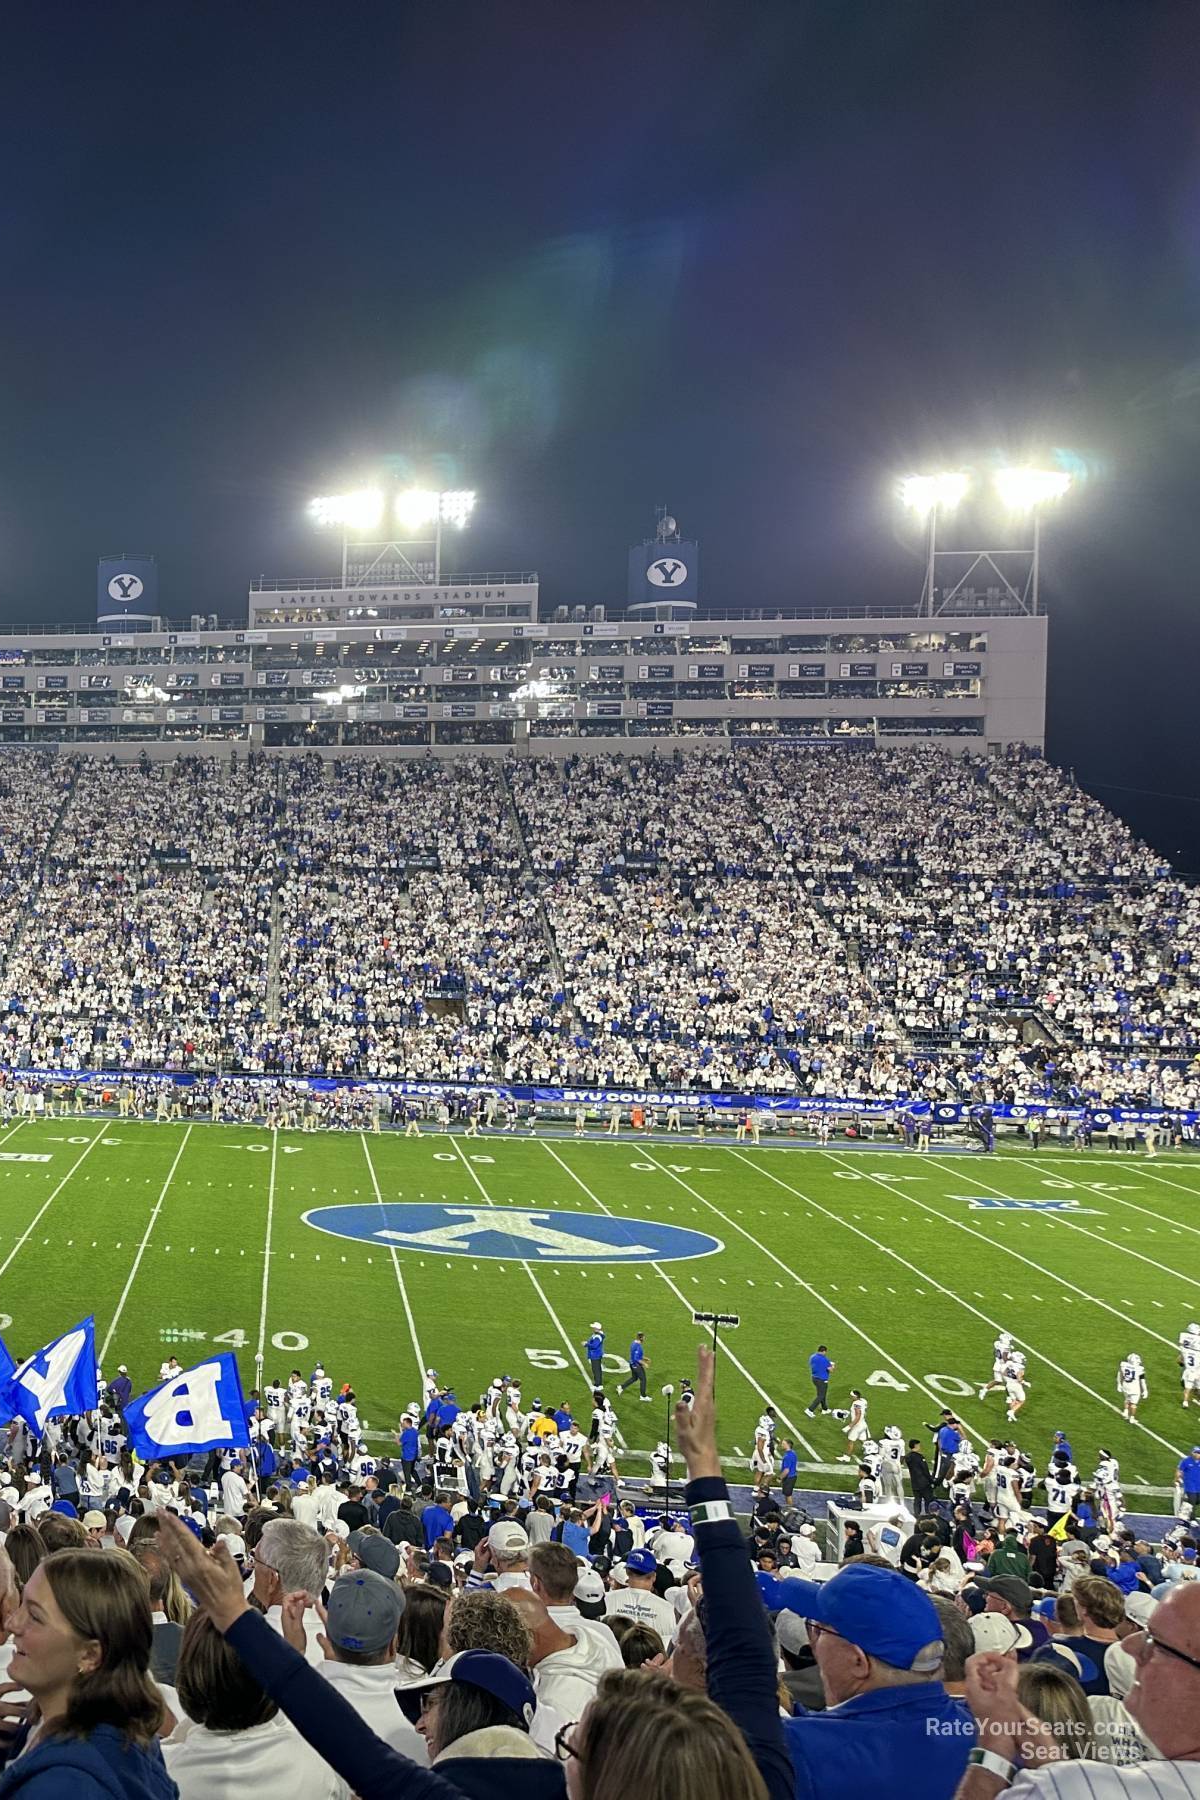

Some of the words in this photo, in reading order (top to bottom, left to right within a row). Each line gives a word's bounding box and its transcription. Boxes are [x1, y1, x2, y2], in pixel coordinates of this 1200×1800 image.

[280, 595, 335, 604] LAVELL
[348, 593, 421, 602] EDWARDS
[433, 590, 506, 600] STADIUM
[366, 1083, 403, 1093] BYU
[564, 1091, 602, 1102] BYU
[606, 1092, 700, 1106] COUGARS
[800, 1101, 825, 1109] BYU
[825, 1101, 887, 1111] FOOTBALL
[67, 1136, 123, 1146] 30
[246, 1144, 303, 1154] 40
[433, 1153, 496, 1164] 50
[629, 1162, 693, 1174] 40
[832, 1171, 902, 1182] 30
[1040, 1179, 1120, 1191] 20
[212, 1328, 310, 1351] 40
[524, 1347, 633, 1374] 50
[1187, 1355, 1195, 1366] 3
[1124, 1368, 1136, 1383] 21
[865, 1369, 976, 1397] 40
[319, 1385, 331, 1398] 25
[267, 1395, 280, 1406] 55
[295, 1406, 309, 1418] 43
[104, 1440, 118, 1455] 96
[565, 1441, 580, 1453] 77
[890, 1448, 898, 1459] 3
[360, 1460, 375, 1475] 96
[1052, 1489, 1066, 1504] 71
[641, 1611, 658, 1619] FIRST
